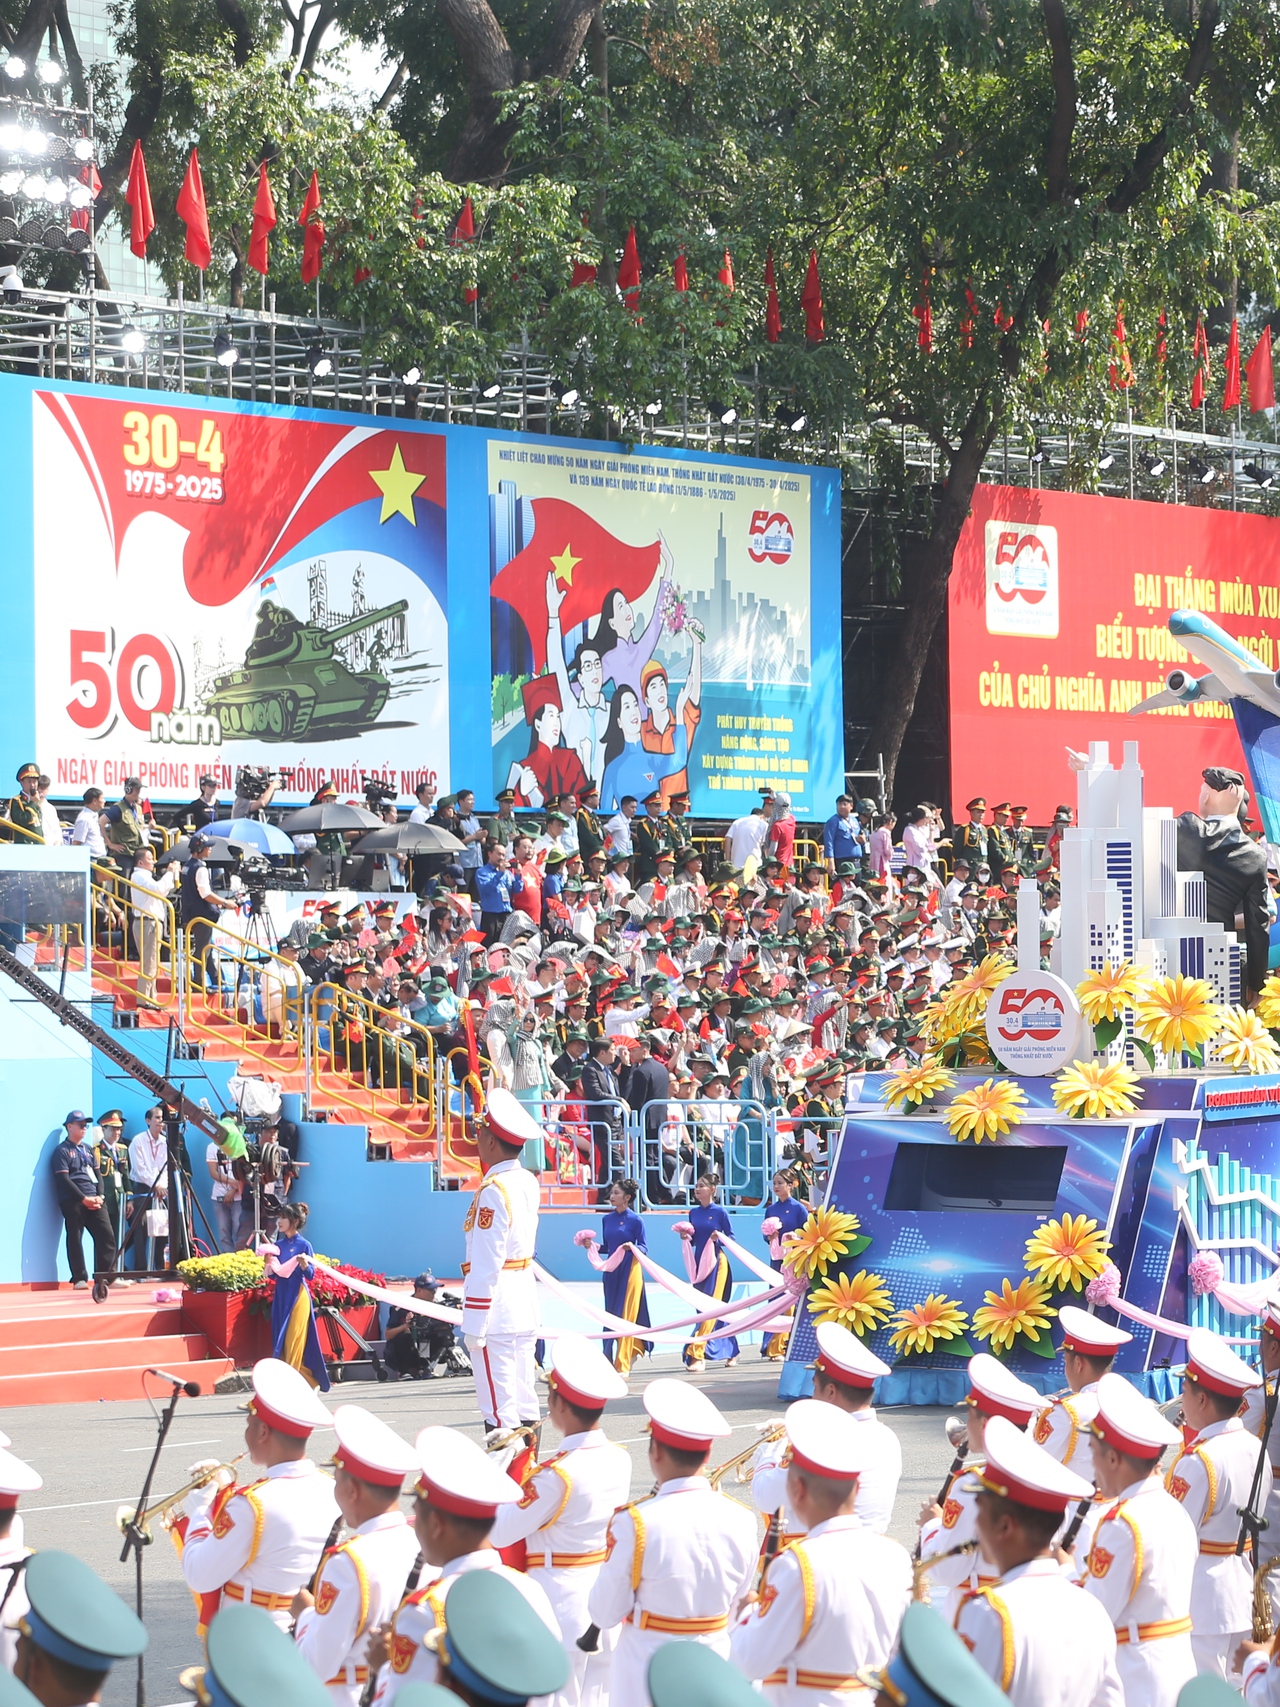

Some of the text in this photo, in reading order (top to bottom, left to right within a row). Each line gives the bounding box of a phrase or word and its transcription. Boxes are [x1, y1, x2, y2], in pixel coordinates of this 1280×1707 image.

[122, 410, 225, 473] 30-4
[499, 449, 515, 463] NHIỆT
[517, 451, 528, 464] LIỆT
[530, 452, 546, 465] CHÀO
[566, 457, 574, 467] 50
[575, 456, 588, 469] NĂM
[620, 461, 639, 474] PHÓNG
[569, 473, 578, 485] VÀ
[579, 475, 590, 486] 139
[591, 475, 604, 488] NĂM
[605, 475, 620, 489] NGÀY
[1134, 572, 1161, 615] ĐẠI
[1164, 565, 1216, 613] THẮNG
[1219, 576, 1255, 617] MÙA
[1096, 611, 1133, 661] BIỂU
[66, 629, 176, 731] 50
[979, 660, 1014, 708] CỦA
[1017, 663, 1052, 711] CHỦ
[1055, 671, 1106, 713] NGHĨA
[1109, 679, 1142, 714] ANH
[150, 706, 222, 745] năm
[57, 752, 98, 785] NGÀY
[104, 751, 133, 786] GIẢI
[139, 756, 189, 789] PHÓNG
[1206, 1091, 1242, 1108] DOANH
[1241, 1085, 1268, 1105] NHÂN
